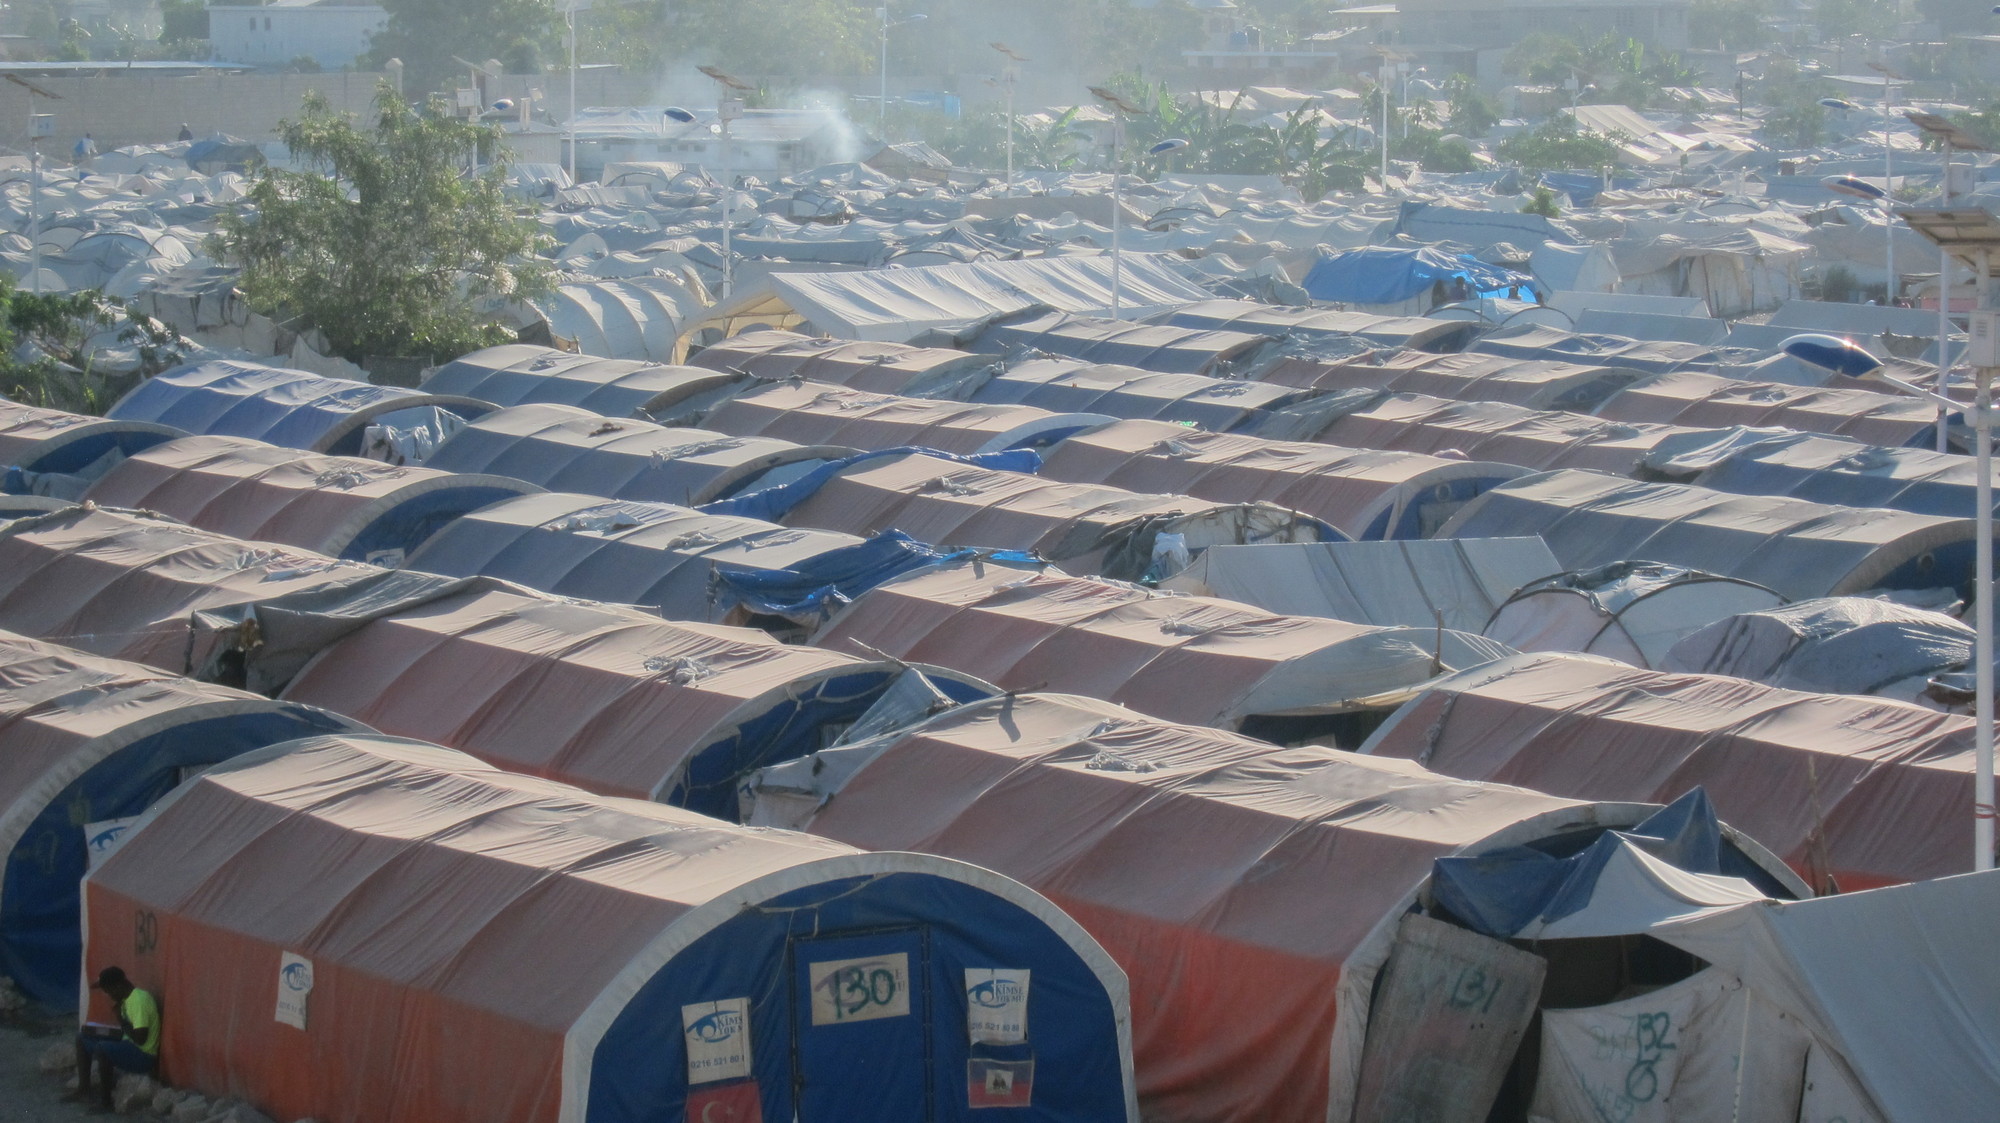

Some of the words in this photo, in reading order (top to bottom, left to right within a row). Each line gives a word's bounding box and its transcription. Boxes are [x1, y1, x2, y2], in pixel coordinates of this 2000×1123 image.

[834, 967, 896, 1020] 130
[1450, 963, 1504, 1014] 131
[691, 1059, 711, 1069] 0216
[714, 1056, 727, 1066] 521
